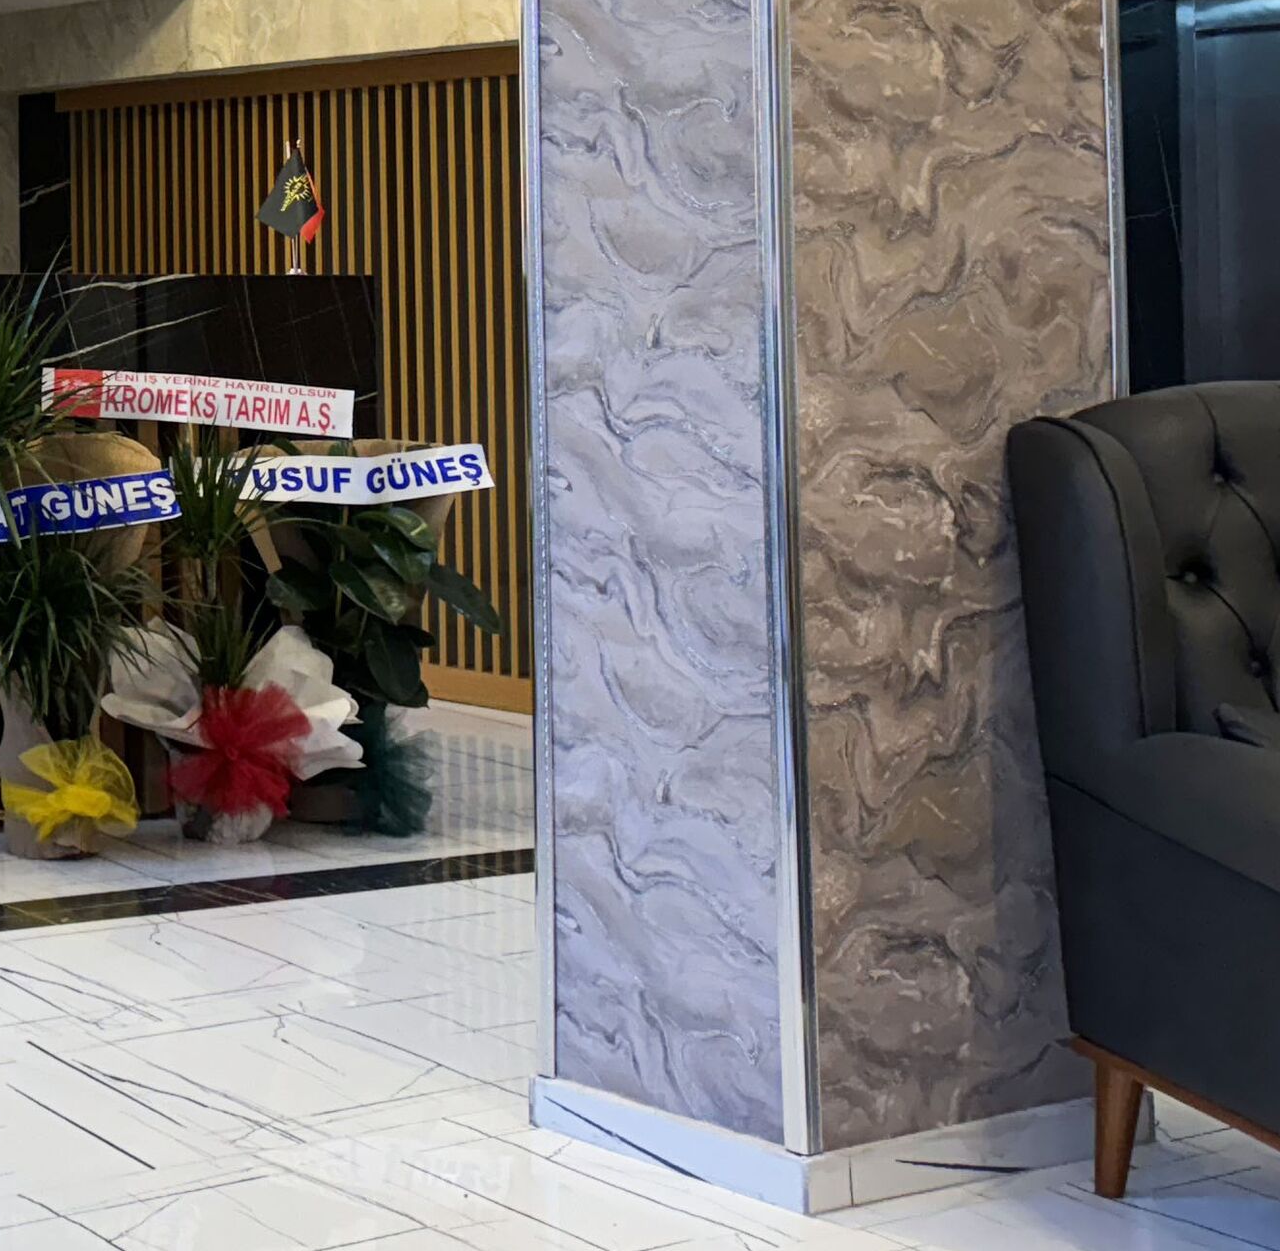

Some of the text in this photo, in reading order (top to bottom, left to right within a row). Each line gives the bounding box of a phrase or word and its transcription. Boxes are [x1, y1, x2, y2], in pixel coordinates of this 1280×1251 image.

[144, 374, 158, 385] İŞ
[162, 374, 220, 388] YERİNİZ
[226, 380, 282, 394] HAYIRLI
[288, 387, 337, 399] OLSUN
[105, 385, 216, 419] KROMEKS
[224, 393, 290, 425] TARIM
[296, 401, 336, 435] A.Ş.
[366, 454, 483, 493] GÜNEŞ
[41, 477, 176, 520] GÜNEŞ
